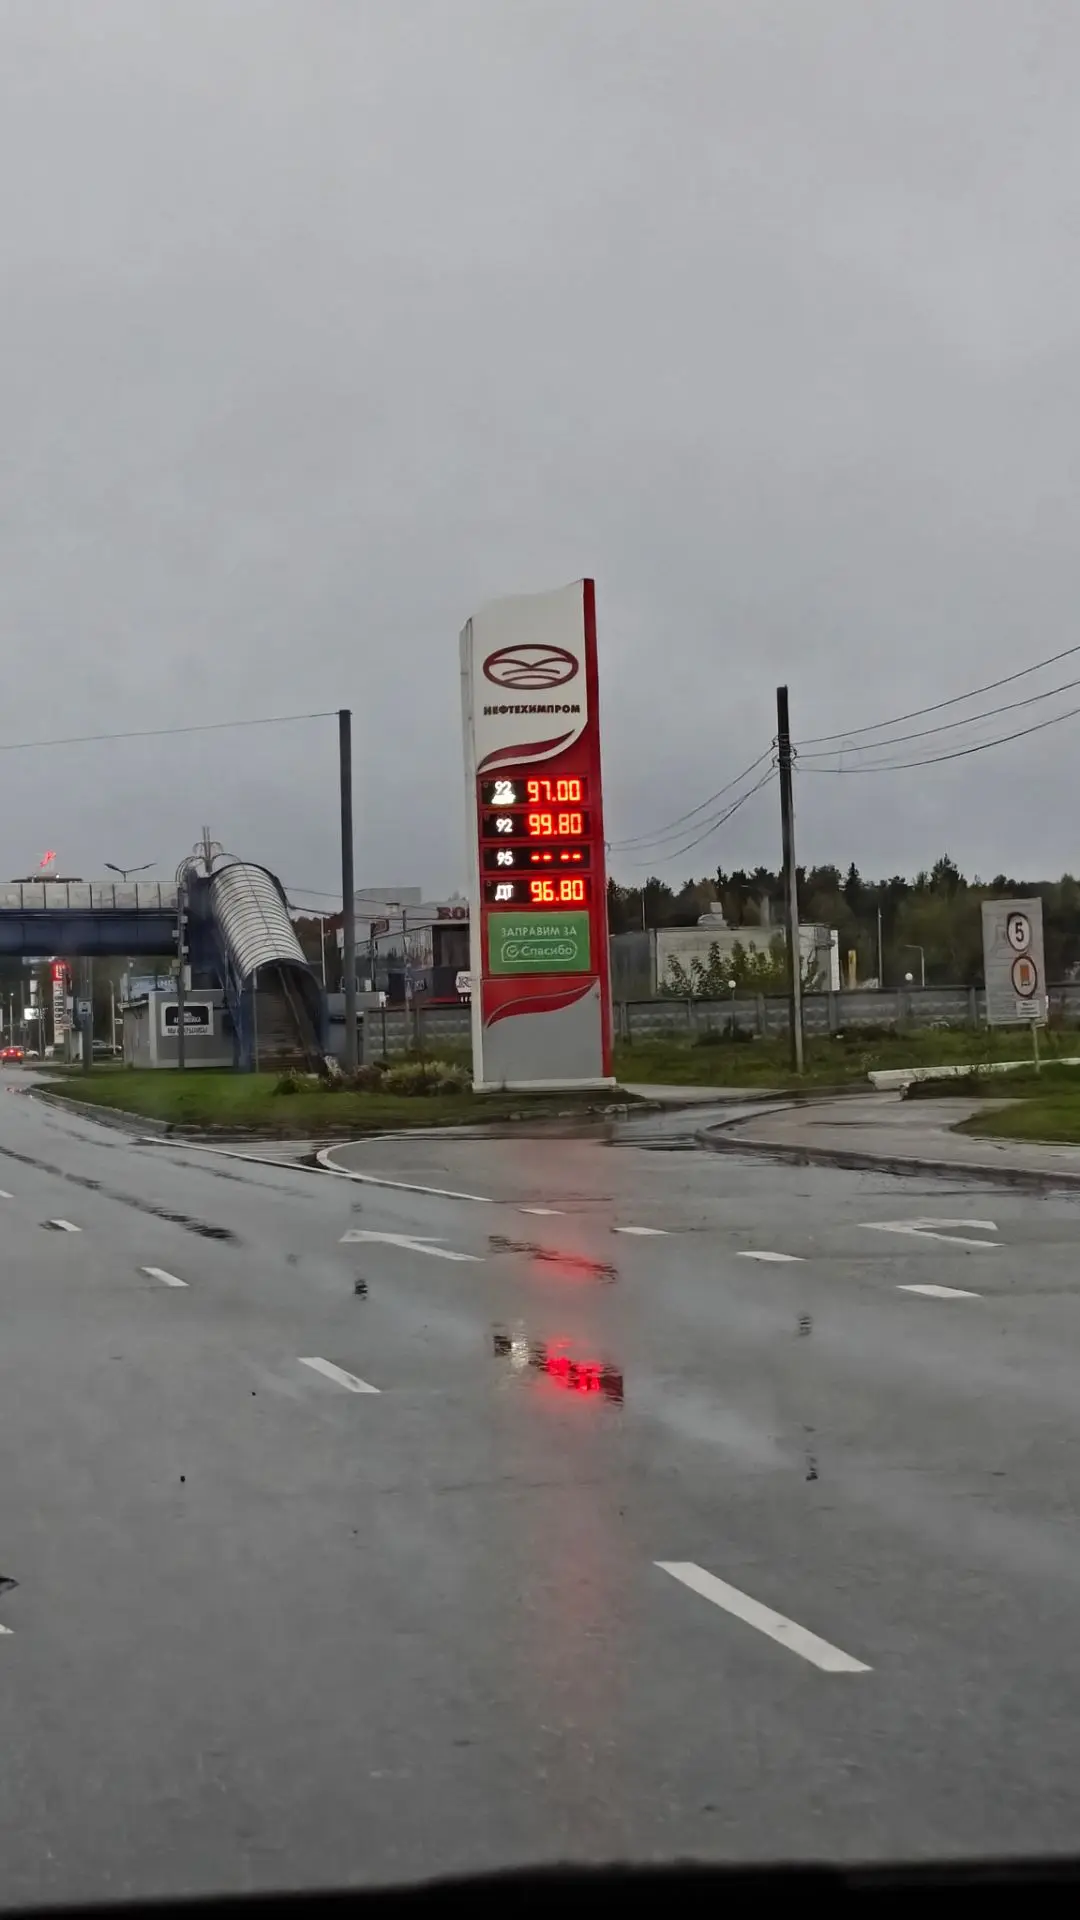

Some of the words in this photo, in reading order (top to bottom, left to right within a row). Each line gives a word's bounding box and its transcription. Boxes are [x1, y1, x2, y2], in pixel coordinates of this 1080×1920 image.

[483, 704, 581, 715] НЕФТЕХИМПРОМ
[527, 780, 580, 802] 97.00
[495, 818, 513, 833] 92
[528, 813, 582, 836] 99.80
[496, 851, 514, 866] 95
[494, 884, 514, 901] ДТ
[530, 880, 584, 902] 96.80
[501, 926, 560, 937] ЗАПРАВИМ
[563, 925, 577, 936] ЗА
[1015, 921, 1025, 942] 5
[520, 944, 573, 957] Спасибо
